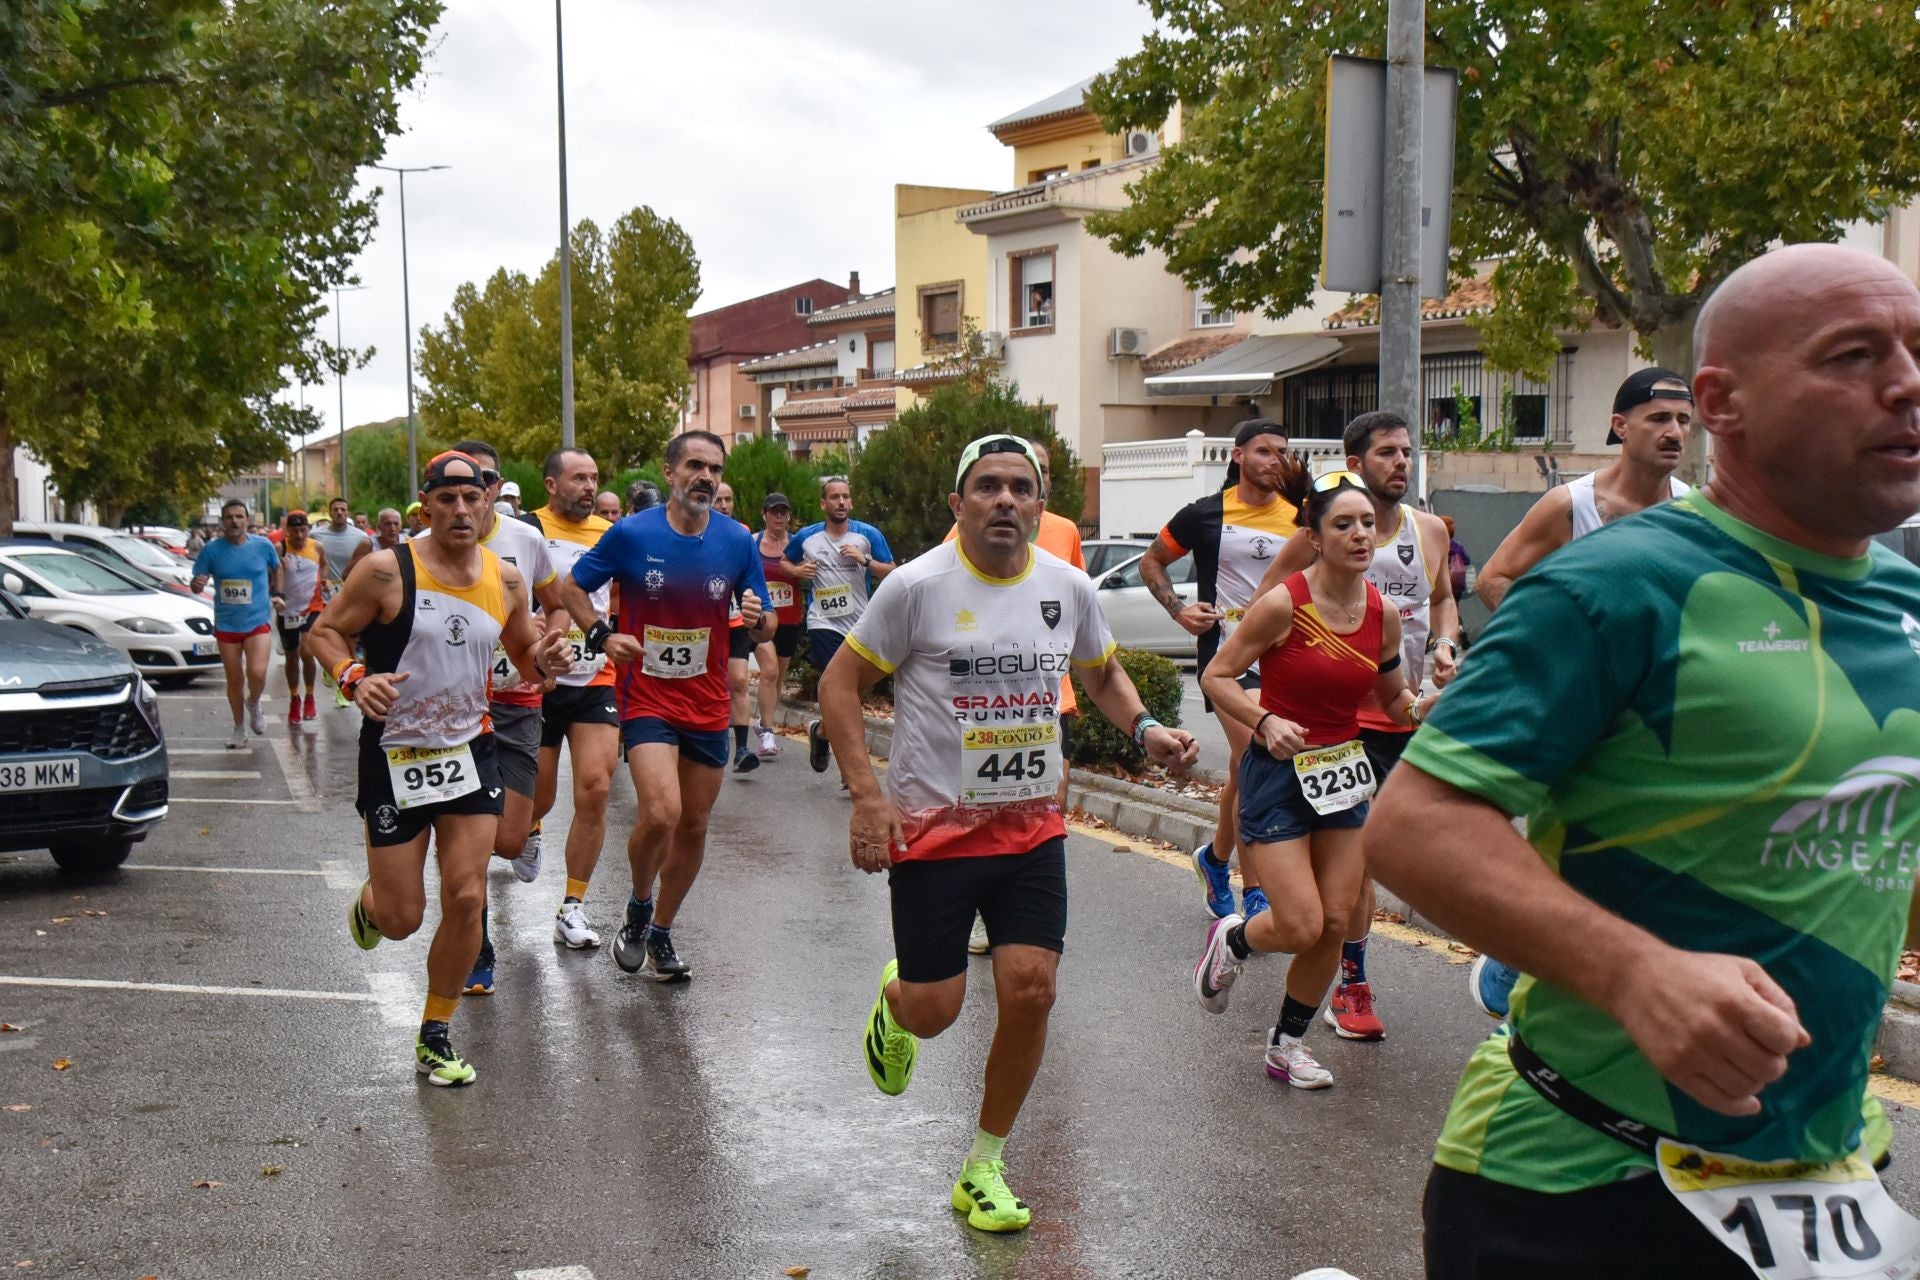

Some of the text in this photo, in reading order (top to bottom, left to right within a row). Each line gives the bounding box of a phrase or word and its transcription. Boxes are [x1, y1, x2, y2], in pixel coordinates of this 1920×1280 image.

[224, 588, 247, 598] 994
[821, 596, 848, 611] 648
[659, 647, 691, 666] 43
[1737, 640, 1809, 652] TEAMERGY
[977, 731, 1042, 744] 38 FONDO
[35, 763, 74, 786] MKM
[404, 760, 465, 790] 952
[977, 749, 1046, 782] 445
[1302, 760, 1372, 800] 3230
[1721, 1194, 1881, 1269] 170
